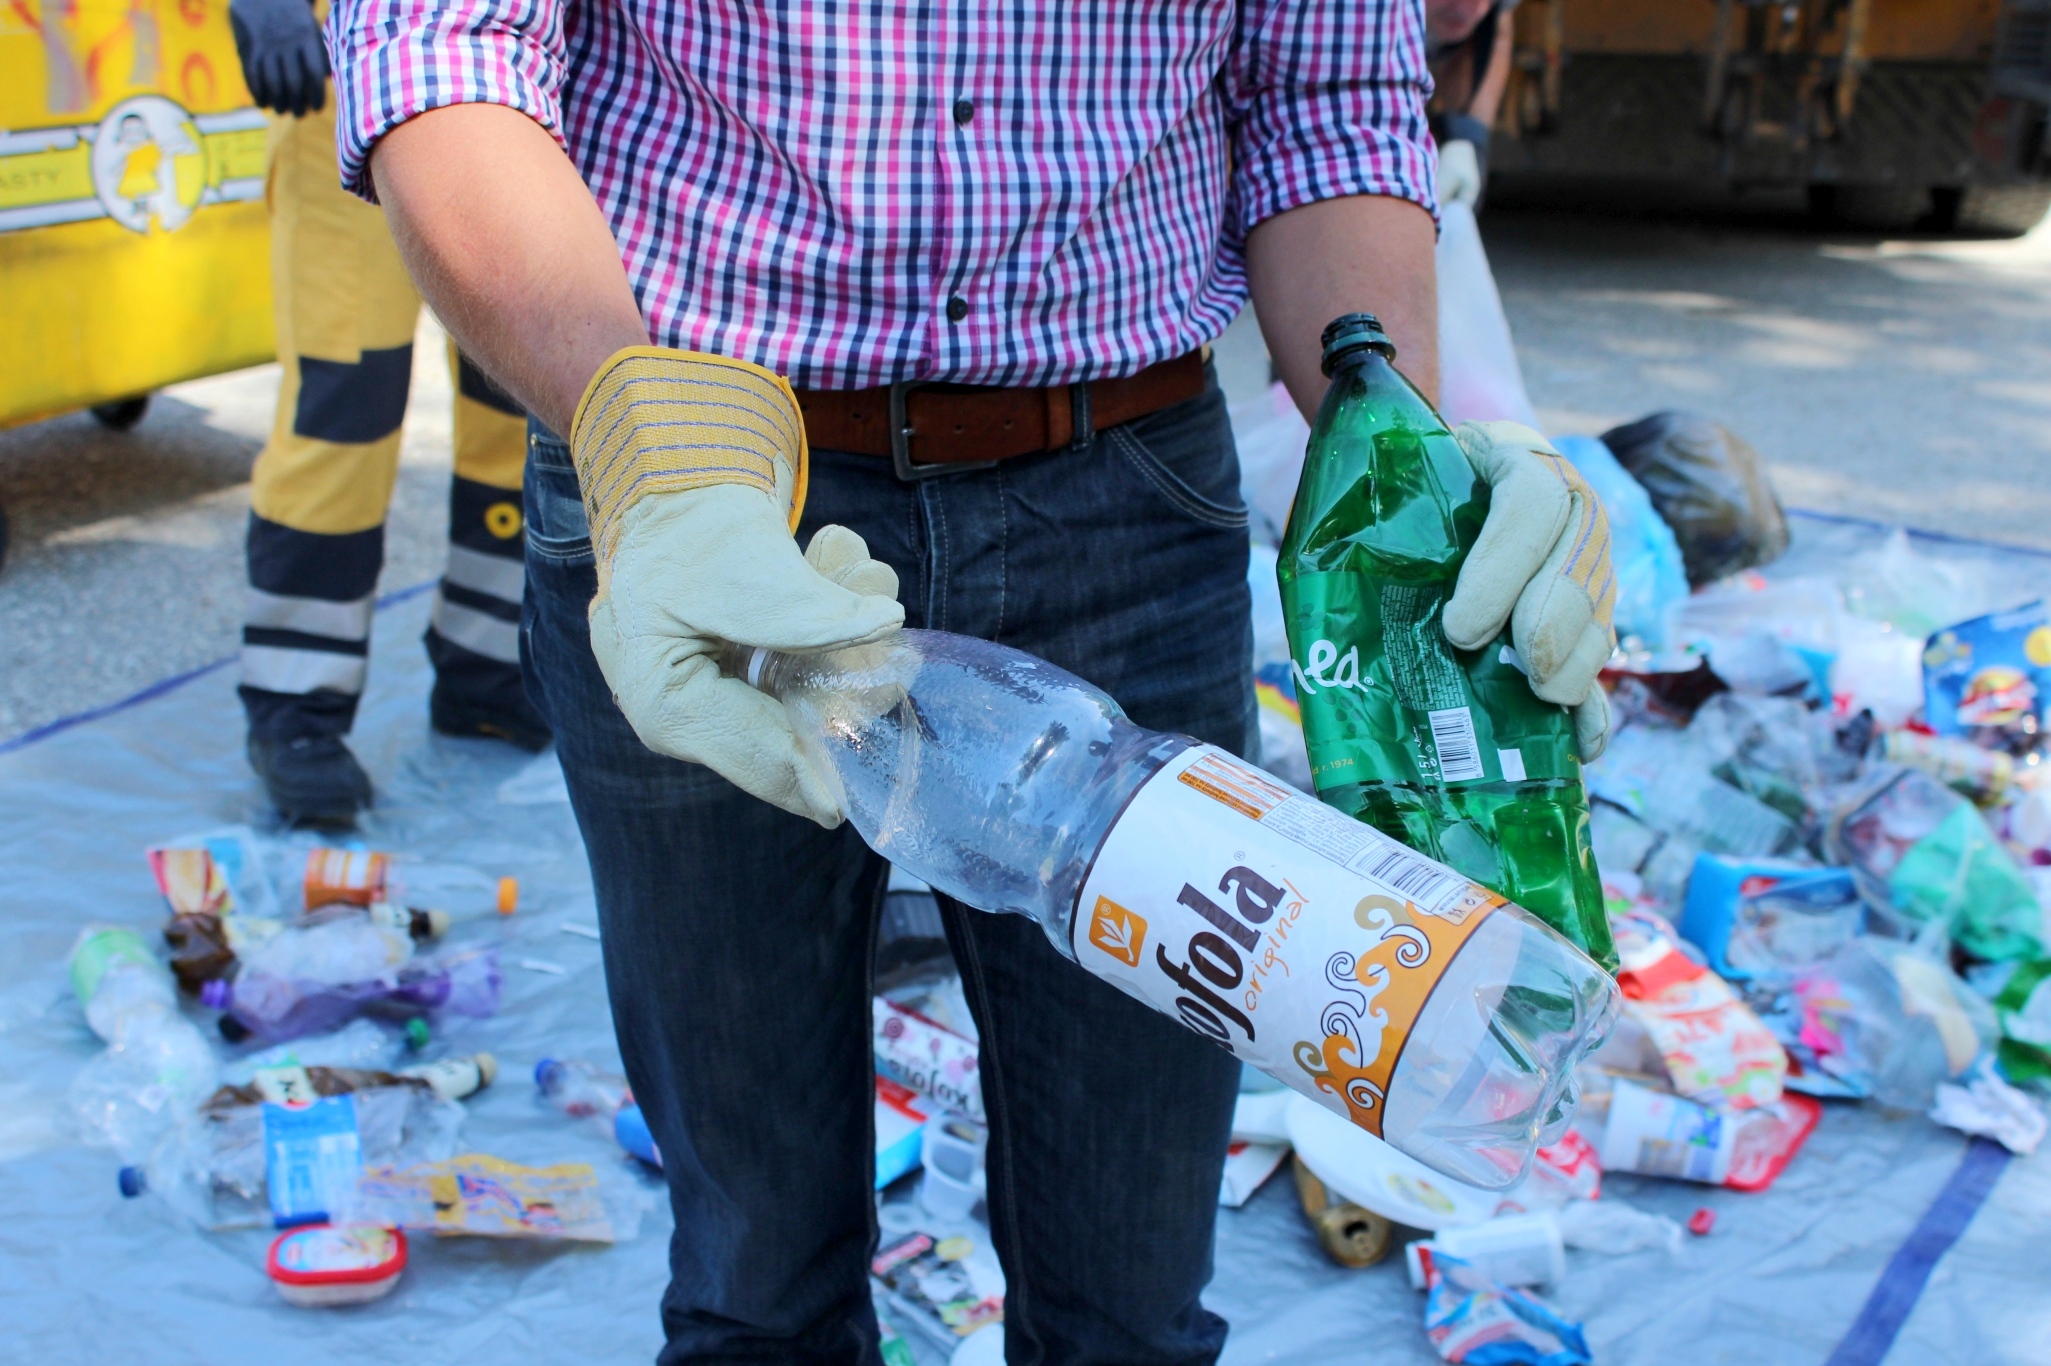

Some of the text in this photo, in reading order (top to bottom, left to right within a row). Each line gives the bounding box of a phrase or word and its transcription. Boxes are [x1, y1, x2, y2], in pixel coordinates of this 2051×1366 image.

[1330, 757, 1355, 769] 1974
[1156, 866, 1287, 1053] ofola
[1245, 878, 1310, 1011] original
